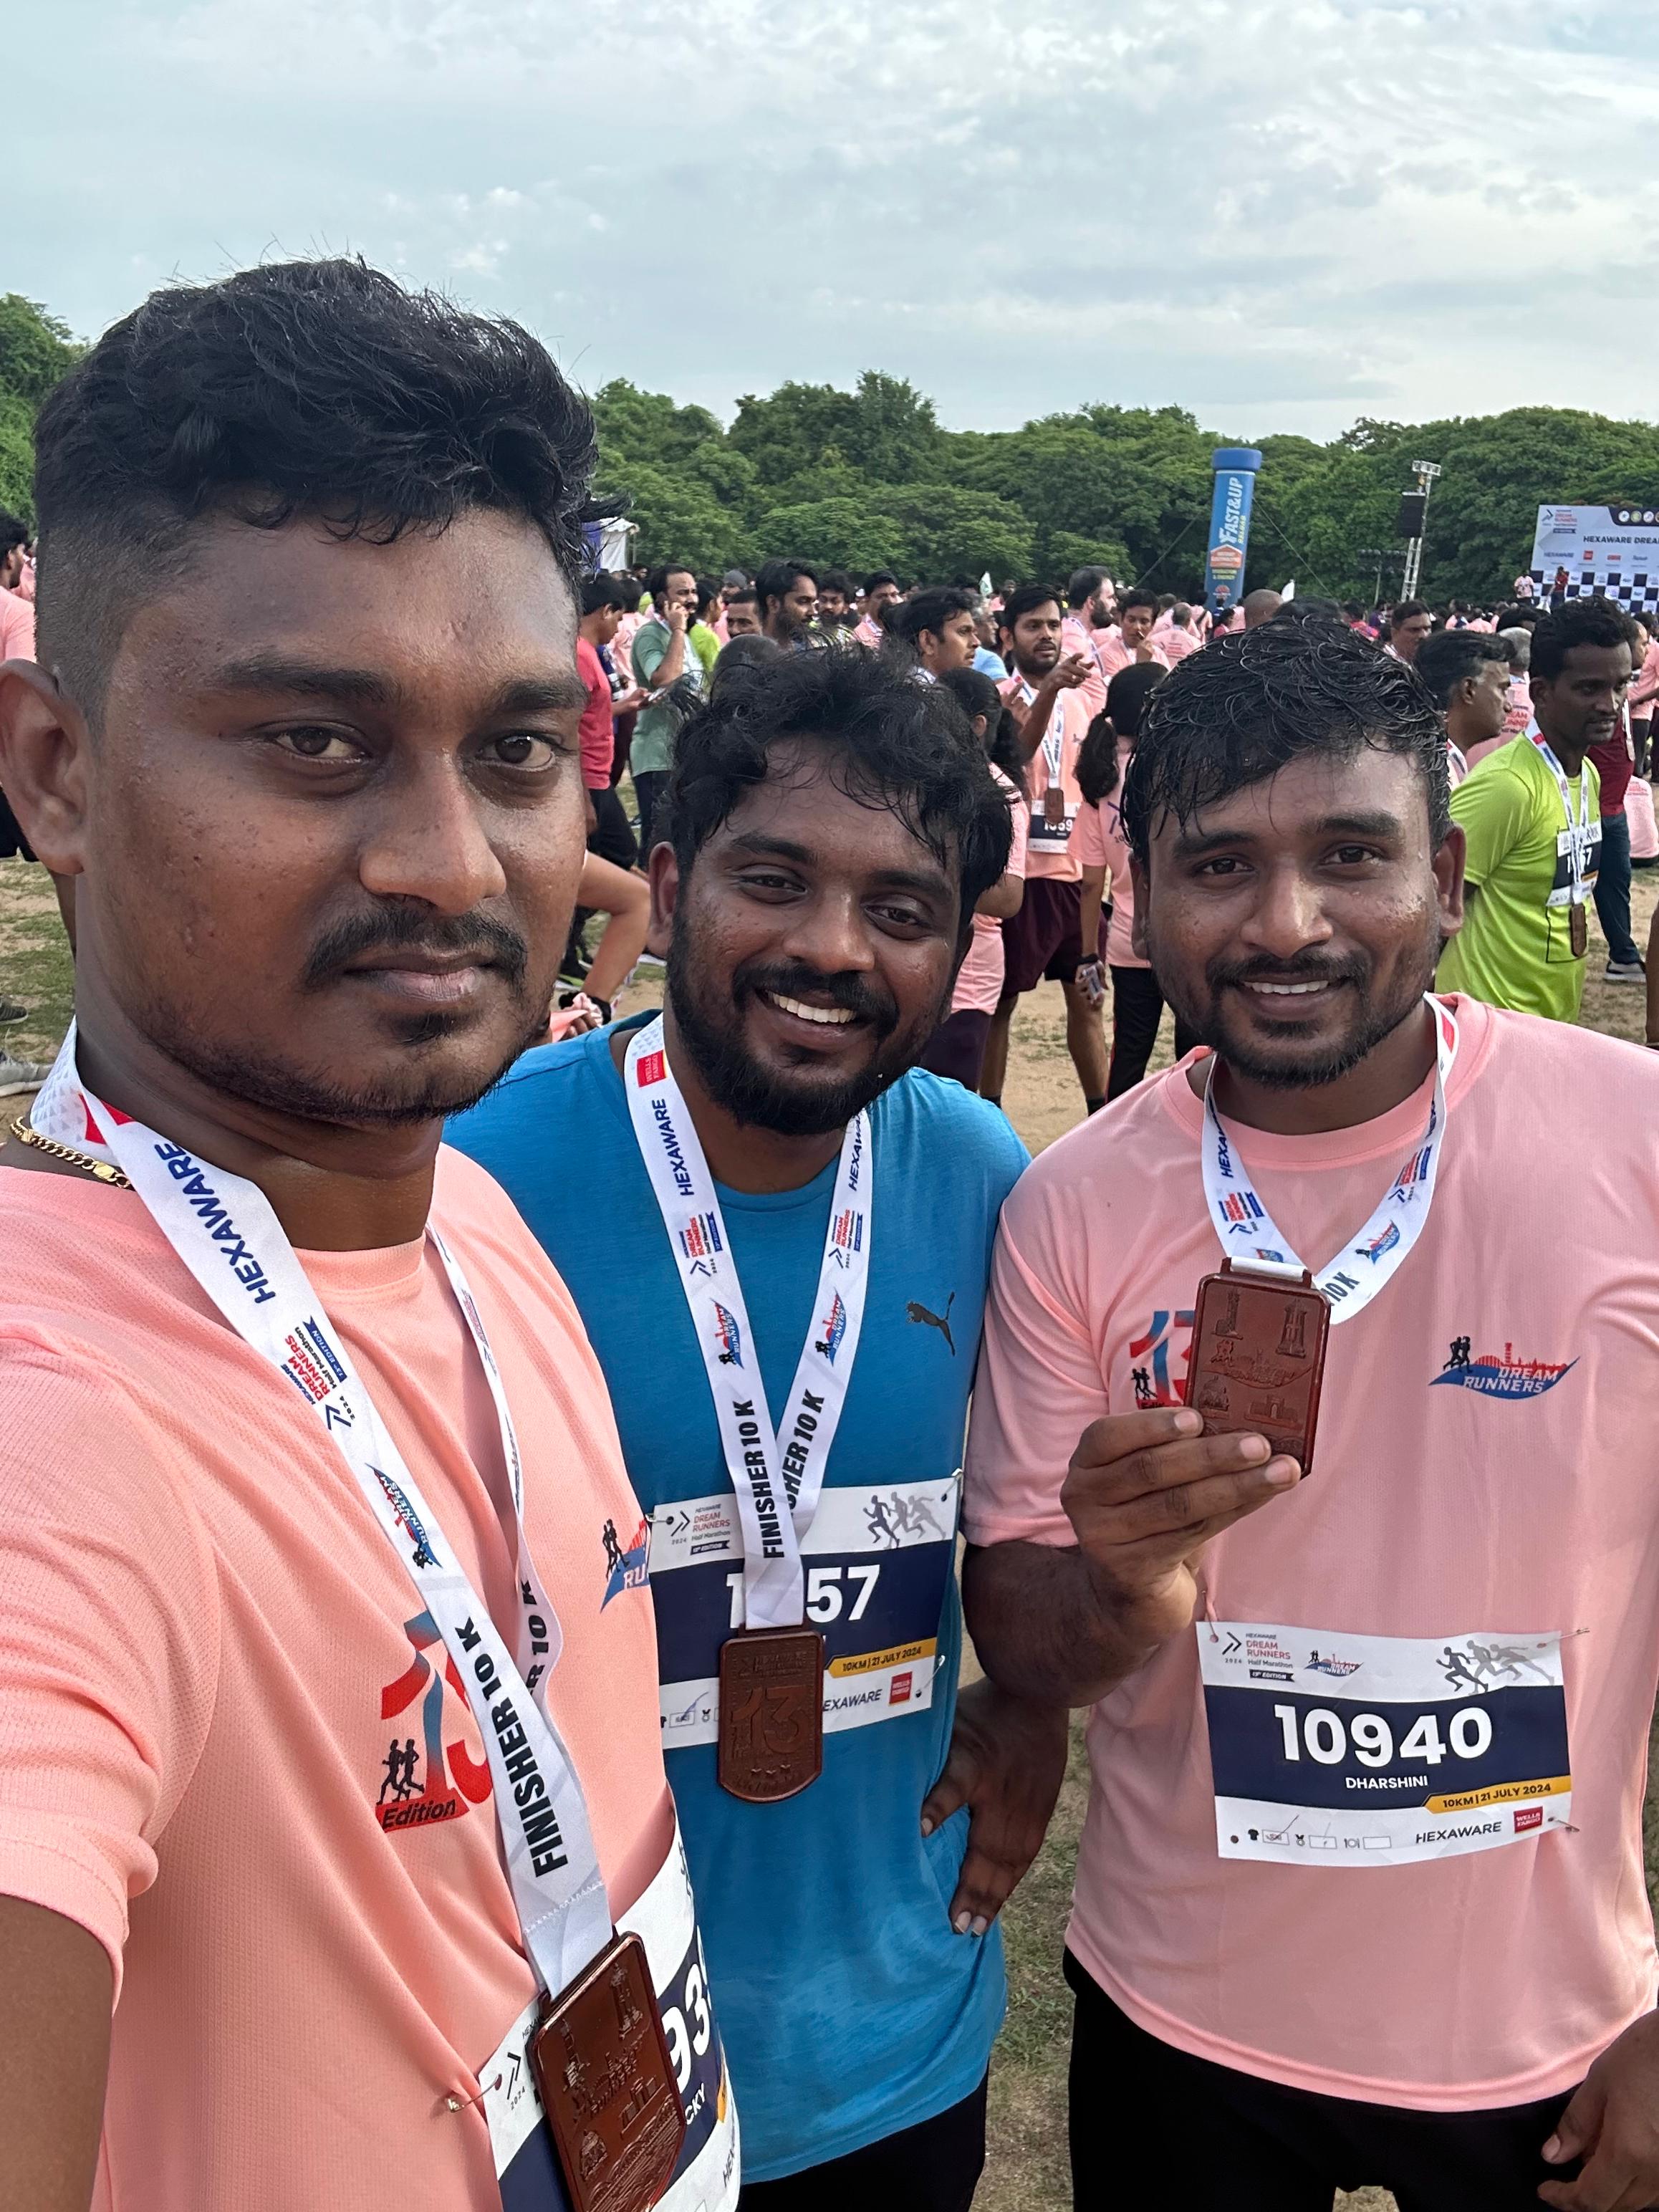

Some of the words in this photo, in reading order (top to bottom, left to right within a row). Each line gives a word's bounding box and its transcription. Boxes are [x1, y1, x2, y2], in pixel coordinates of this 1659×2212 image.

[1219, 477, 1243, 544] FAST&UP
[652, 1098, 694, 1196] HEXAWARE
[848, 1115, 862, 1191] HEXAWA
[154, 1143, 276, 1304] HEXAWARE
[690, 1216, 706, 1256] RUNNERS
[841, 1209, 851, 1248] RUNNERS
[686, 1229, 698, 1257] DREAM
[1332, 1271, 1360, 1289] K
[725, 1312, 741, 1352] RUNNERS
[833, 1308, 846, 1350] RUNNERS
[294, 1327, 324, 1370] Marathon
[312, 1330, 337, 1363] EDITION
[285, 1335, 330, 1395] RUNNERS
[288, 1356, 324, 1401] DREAM
[1498, 1366, 1559, 1382] DREAM
[322, 1370, 337, 1390] Half
[1462, 1375, 1545, 1393] RUNNERS
[339, 1395, 356, 1420] 2024
[733, 1400, 754, 1416] K
[802, 1388, 824, 1413] K
[739, 1422, 761, 1446] 10
[794, 1413, 818, 1442] 10
[389, 1482, 429, 1544] RUNNERS
[693, 1511, 721, 1524] DREAM
[744, 1451, 784, 1559] FINISHER
[693, 1519, 731, 1532] RUNNERS
[521, 1579, 537, 1605] K
[454, 1616, 482, 1653] K
[528, 1615, 549, 1657] 10
[1246, 1640, 1278, 1650] DREAM
[880, 1651, 902, 1664] JULY
[1247, 1649, 1291, 1660] RUNNERS
[1263, 1660, 1293, 1668] Marathon
[474, 1653, 503, 1702] 10
[1317, 1666, 1350, 1675] RUNNERS
[824, 1688, 883, 1712] EXAWARE
[1274, 1704, 1492, 1768] 10940
[491, 1696, 569, 1877] FINISHER
[1345, 1775, 1428, 1789] DHARSHINI
[1443, 1798, 1473, 1808] 10KM
[1481, 1792, 1490, 1801] 21
[1494, 1788, 1520, 1799] JULY
[1523, 1784, 1551, 1795] 2024
[383, 1799, 456, 1831] Edition
[1516, 1812, 1541, 1822] WELLS
[1517, 1817, 1541, 1827] FARGO
[1415, 1822, 1502, 1844] HEXAWARE
[511, 2086, 526, 2110] 2024
[685, 2082, 706, 2125] CKY
